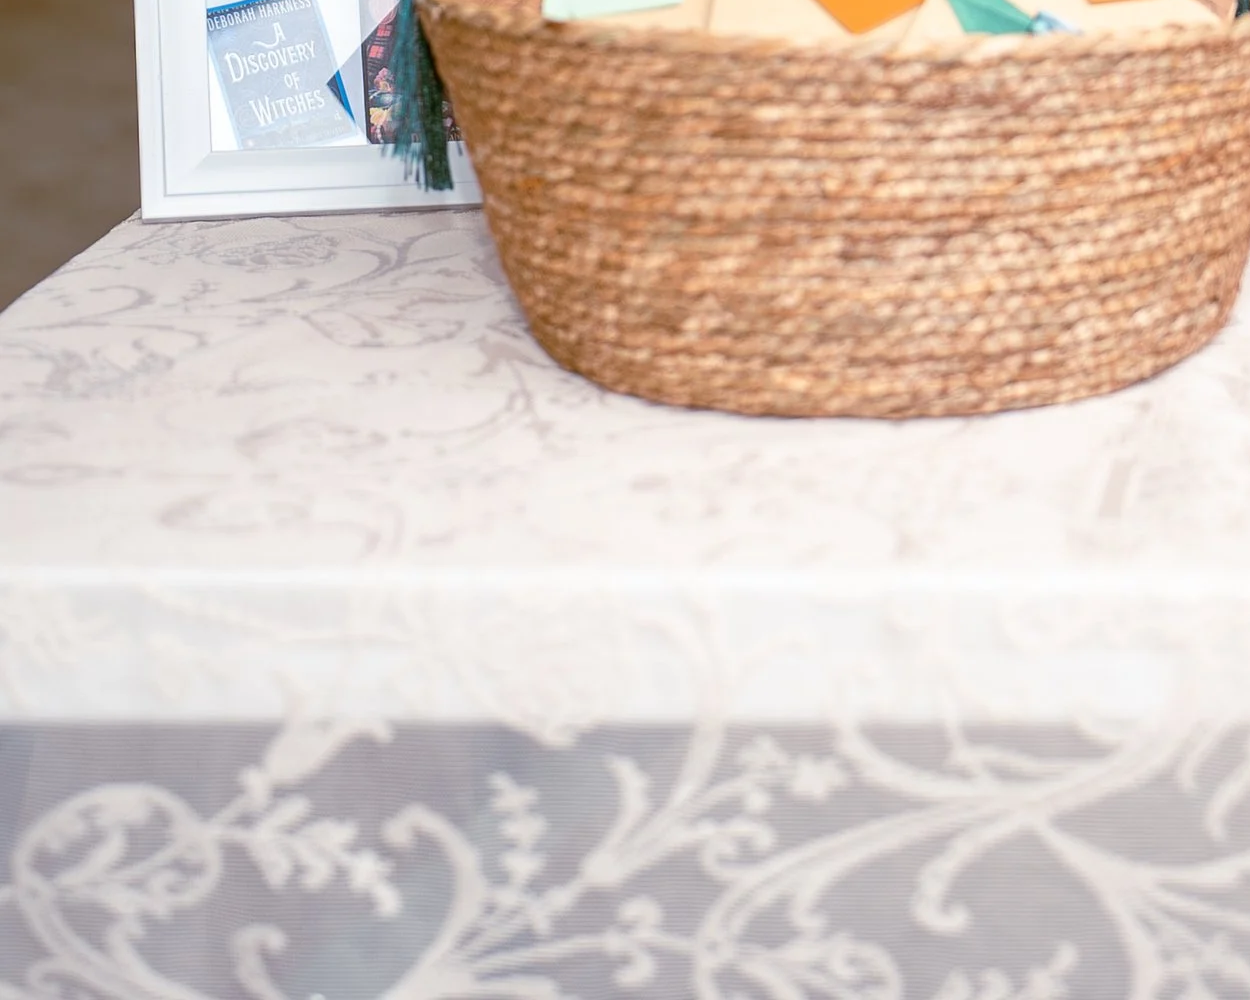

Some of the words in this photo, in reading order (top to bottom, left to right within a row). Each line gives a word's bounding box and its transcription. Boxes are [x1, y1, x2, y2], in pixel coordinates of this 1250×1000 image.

[207, 6, 256, 32] DEBORAH
[224, 40, 318, 84] DISCOVERY
[283, 72, 301, 91] OF
[249, 89, 326, 128] WITCHES
